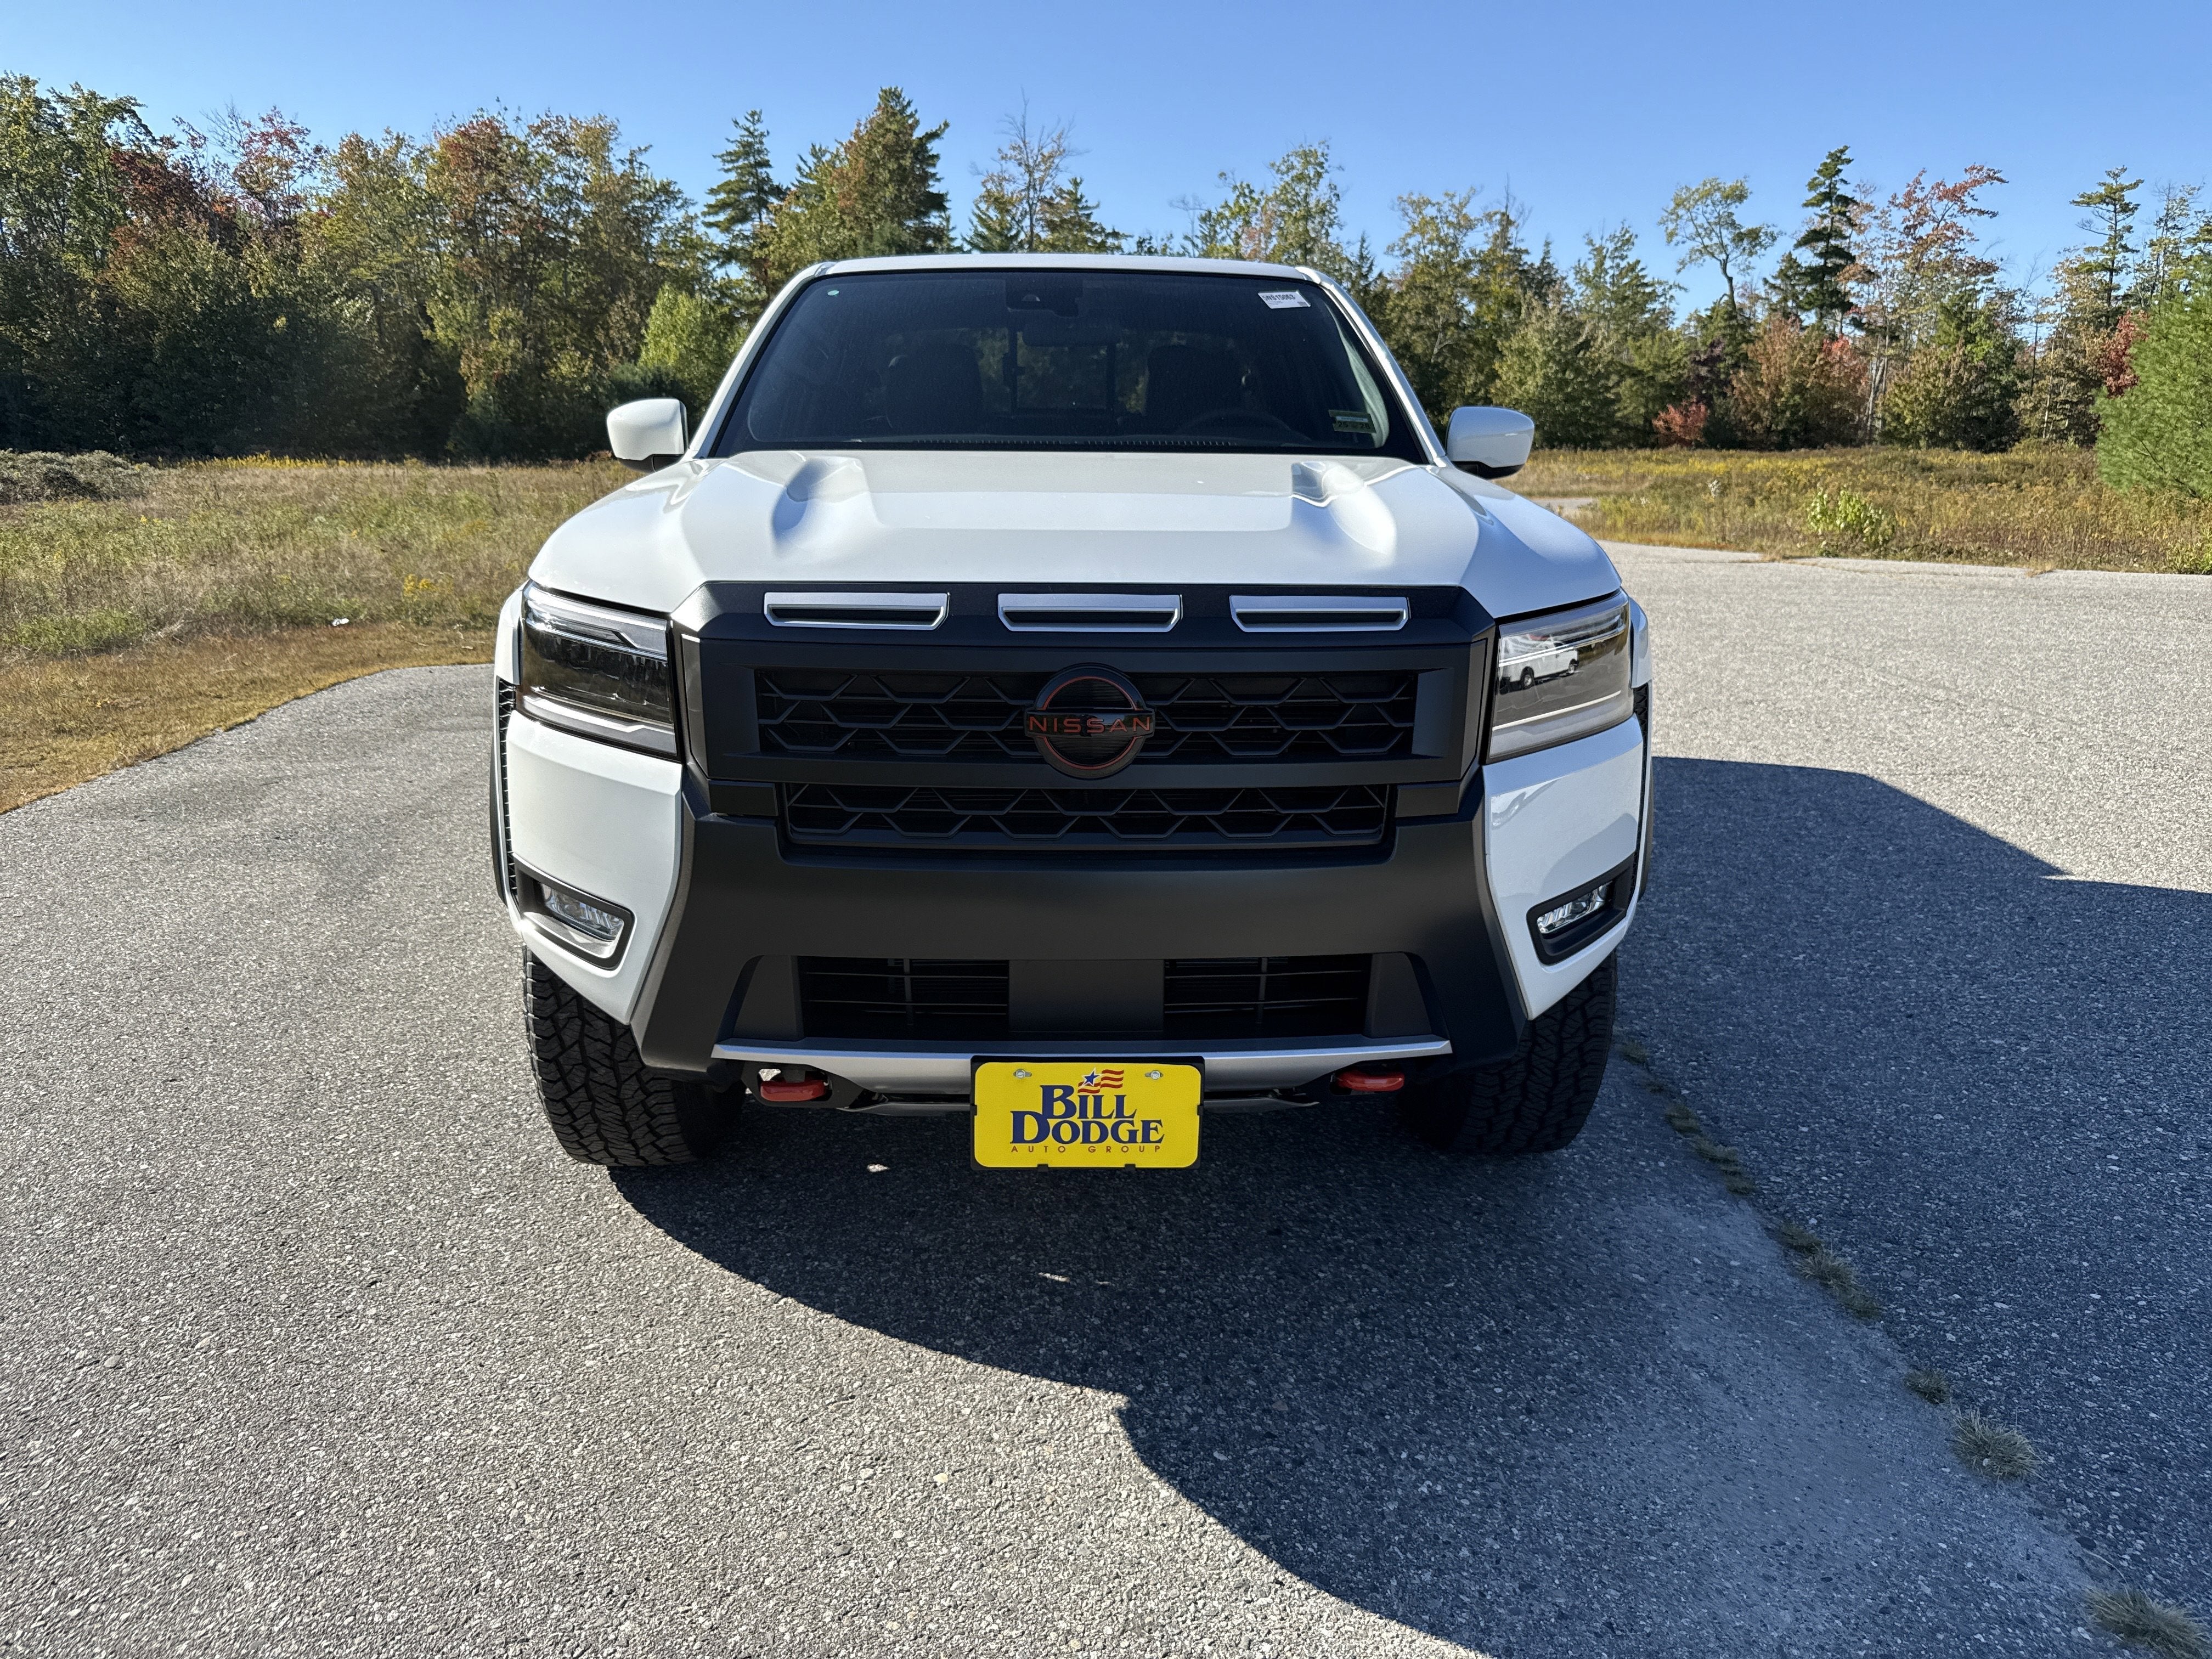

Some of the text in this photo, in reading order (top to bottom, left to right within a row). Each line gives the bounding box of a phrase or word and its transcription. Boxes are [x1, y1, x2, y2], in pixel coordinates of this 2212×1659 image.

[1029, 716, 1150, 733] NISSAN
[1040, 1085, 1137, 1119] BILL
[1010, 1111, 1165, 1144] DODGE
